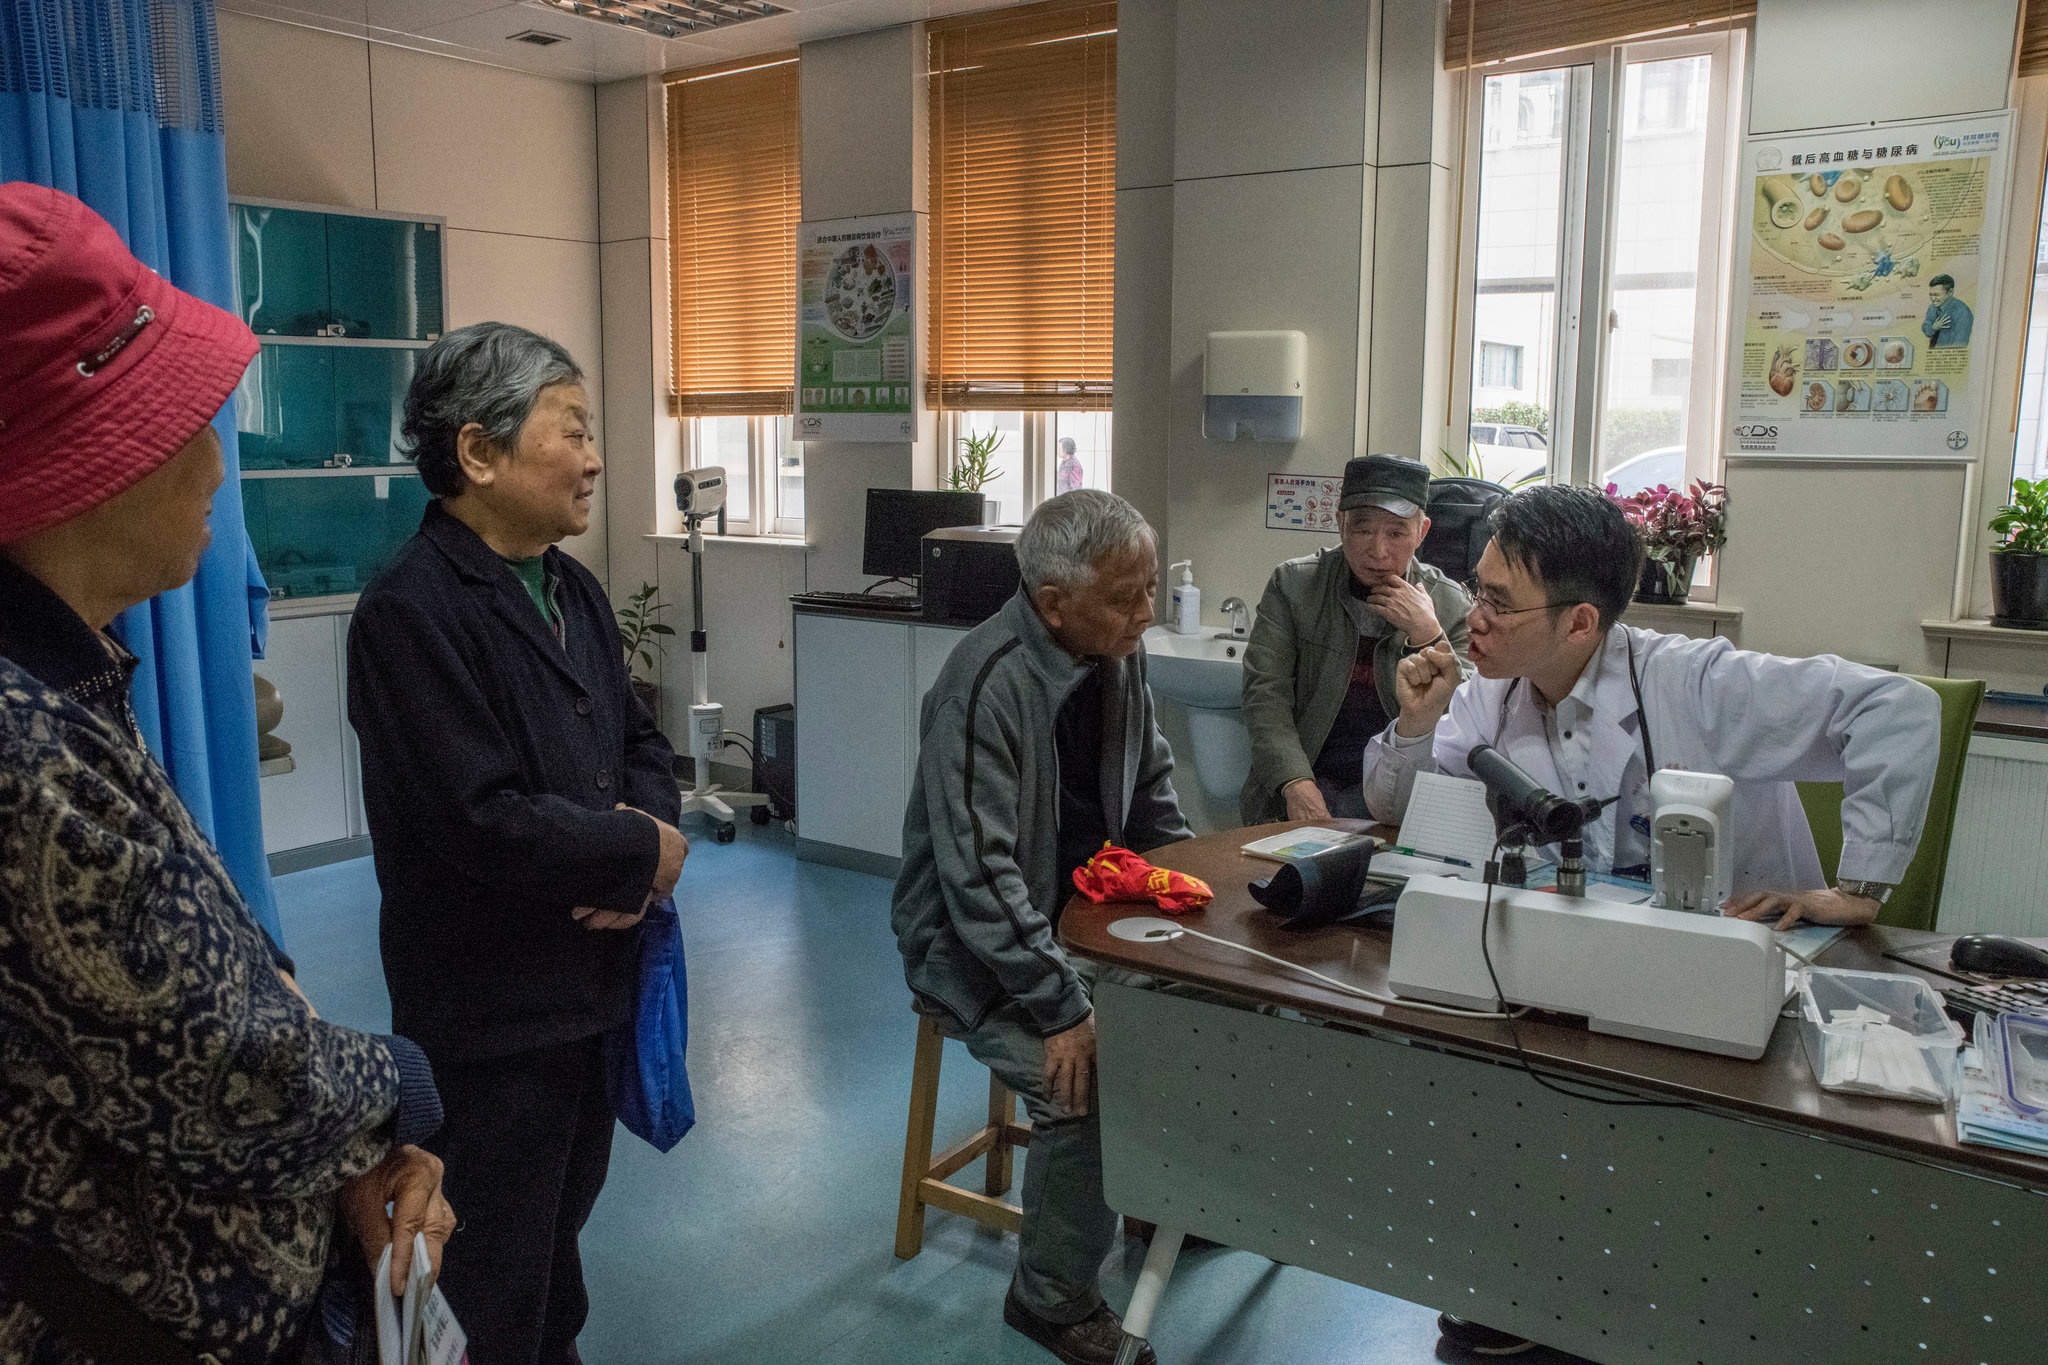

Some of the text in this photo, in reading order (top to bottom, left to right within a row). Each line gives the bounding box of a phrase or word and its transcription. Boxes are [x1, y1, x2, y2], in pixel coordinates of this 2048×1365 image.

[1791, 143, 1918, 166] 餐后高血糖与糖尿病
